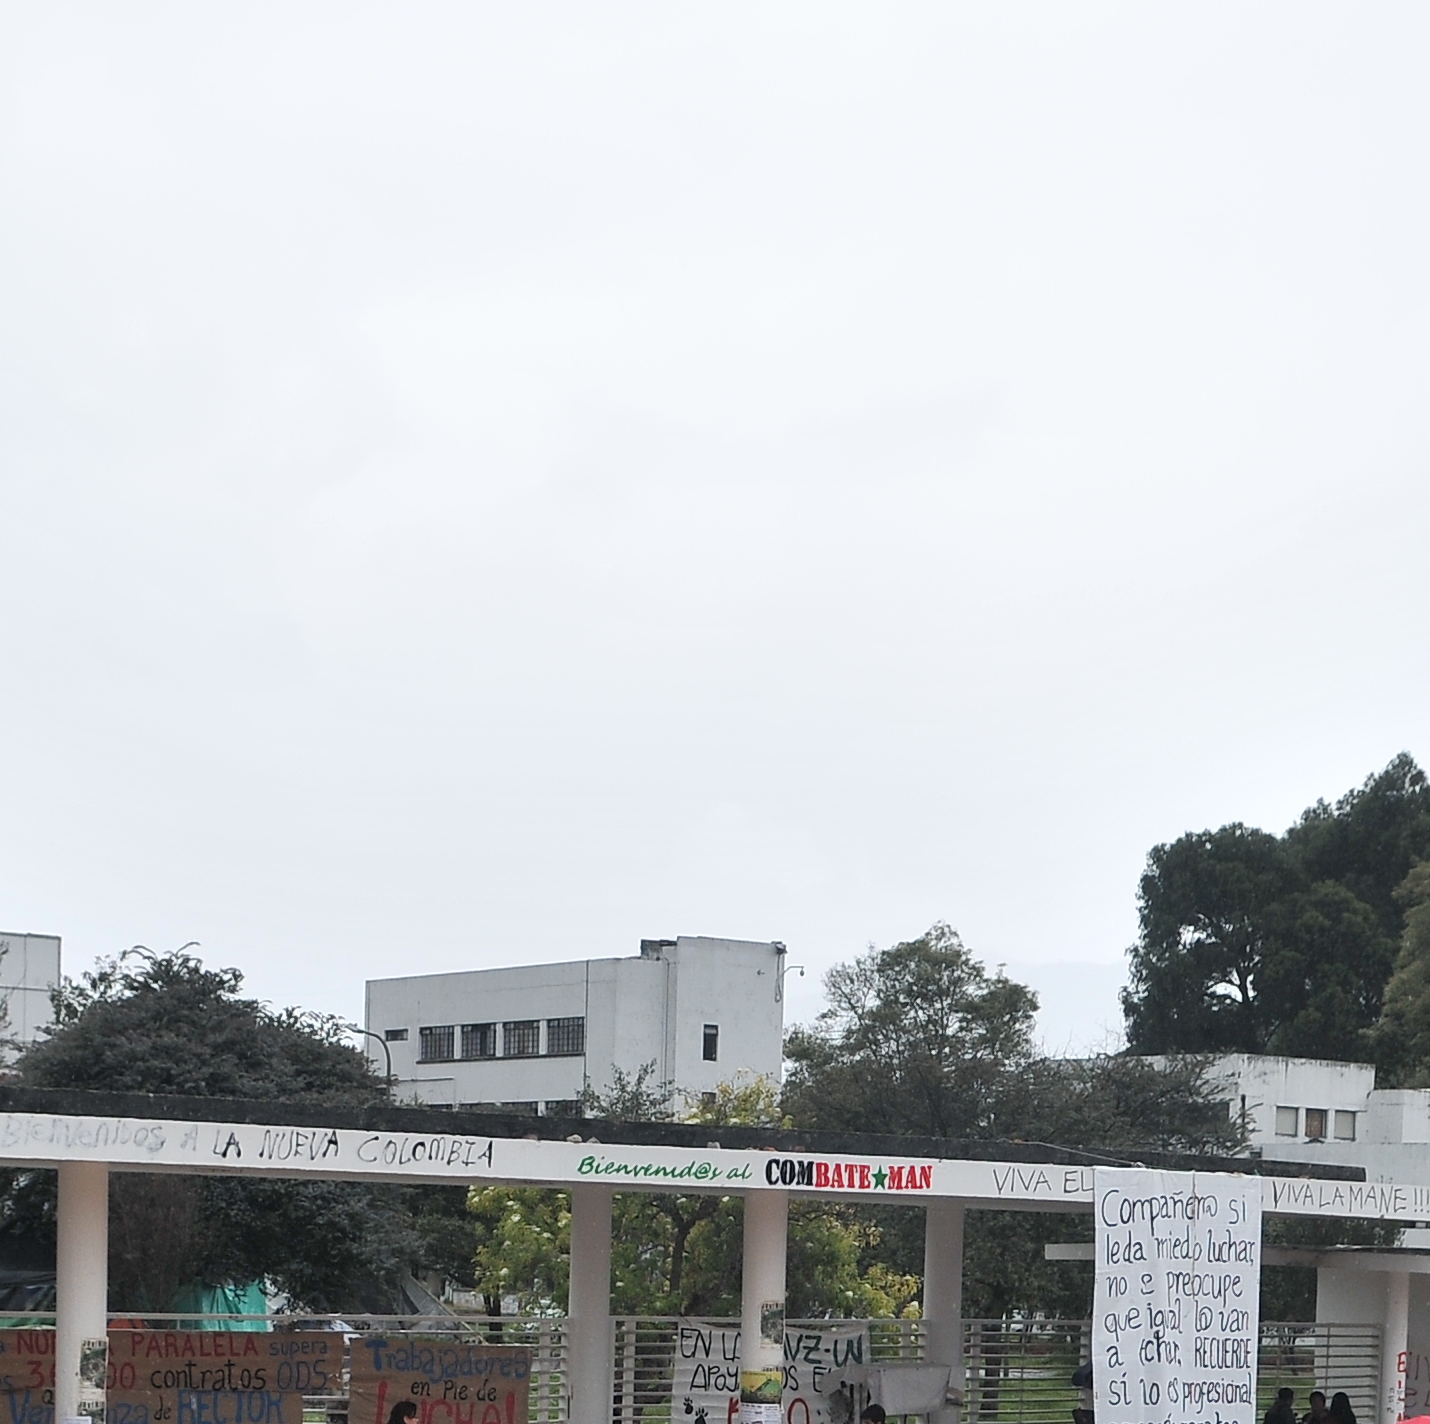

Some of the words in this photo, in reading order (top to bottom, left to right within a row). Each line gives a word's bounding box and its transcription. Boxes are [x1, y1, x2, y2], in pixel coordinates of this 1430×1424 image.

[214, 1130, 240, 1159] LA
[259, 1129, 339, 1160] NUEVA
[357, 1135, 493, 1170] COLOMBIA
[726, 1164, 754, 1180] al
[993, 1168, 1052, 1195] VIVA
[1063, 1170, 1095, 1193] EL
[1272, 1180, 1314, 1210] VIVA
[1319, 1183, 1345, 1208] LA
[1106, 1273, 1128, 1298] no
[1166, 1271, 1244, 1310] preocupe
[1104, 1305, 1141, 1341] que
[1218, 1308, 1250, 1333] van
[130, 1332, 260, 1358] PARALELA
[269, 1337, 328, 1357] supera
[680, 1327, 713, 1358] EN
[1106, 1345, 1124, 1369] a
[1193, 1336, 1252, 1370] RECUERDE
[150, 1360, 268, 1392] contratos
[276, 1360, 328, 1391] ODS
[365, 1338, 531, 1384] Trabajadores
[410, 1379, 431, 1398] en
[476, 1378, 497, 1402] de
[812, 1366, 832, 1393] E
[1139, 1377, 1161, 1406] lo
[1182, 1372, 1253, 1414] profesional
[153, 1396, 170, 1422] de
